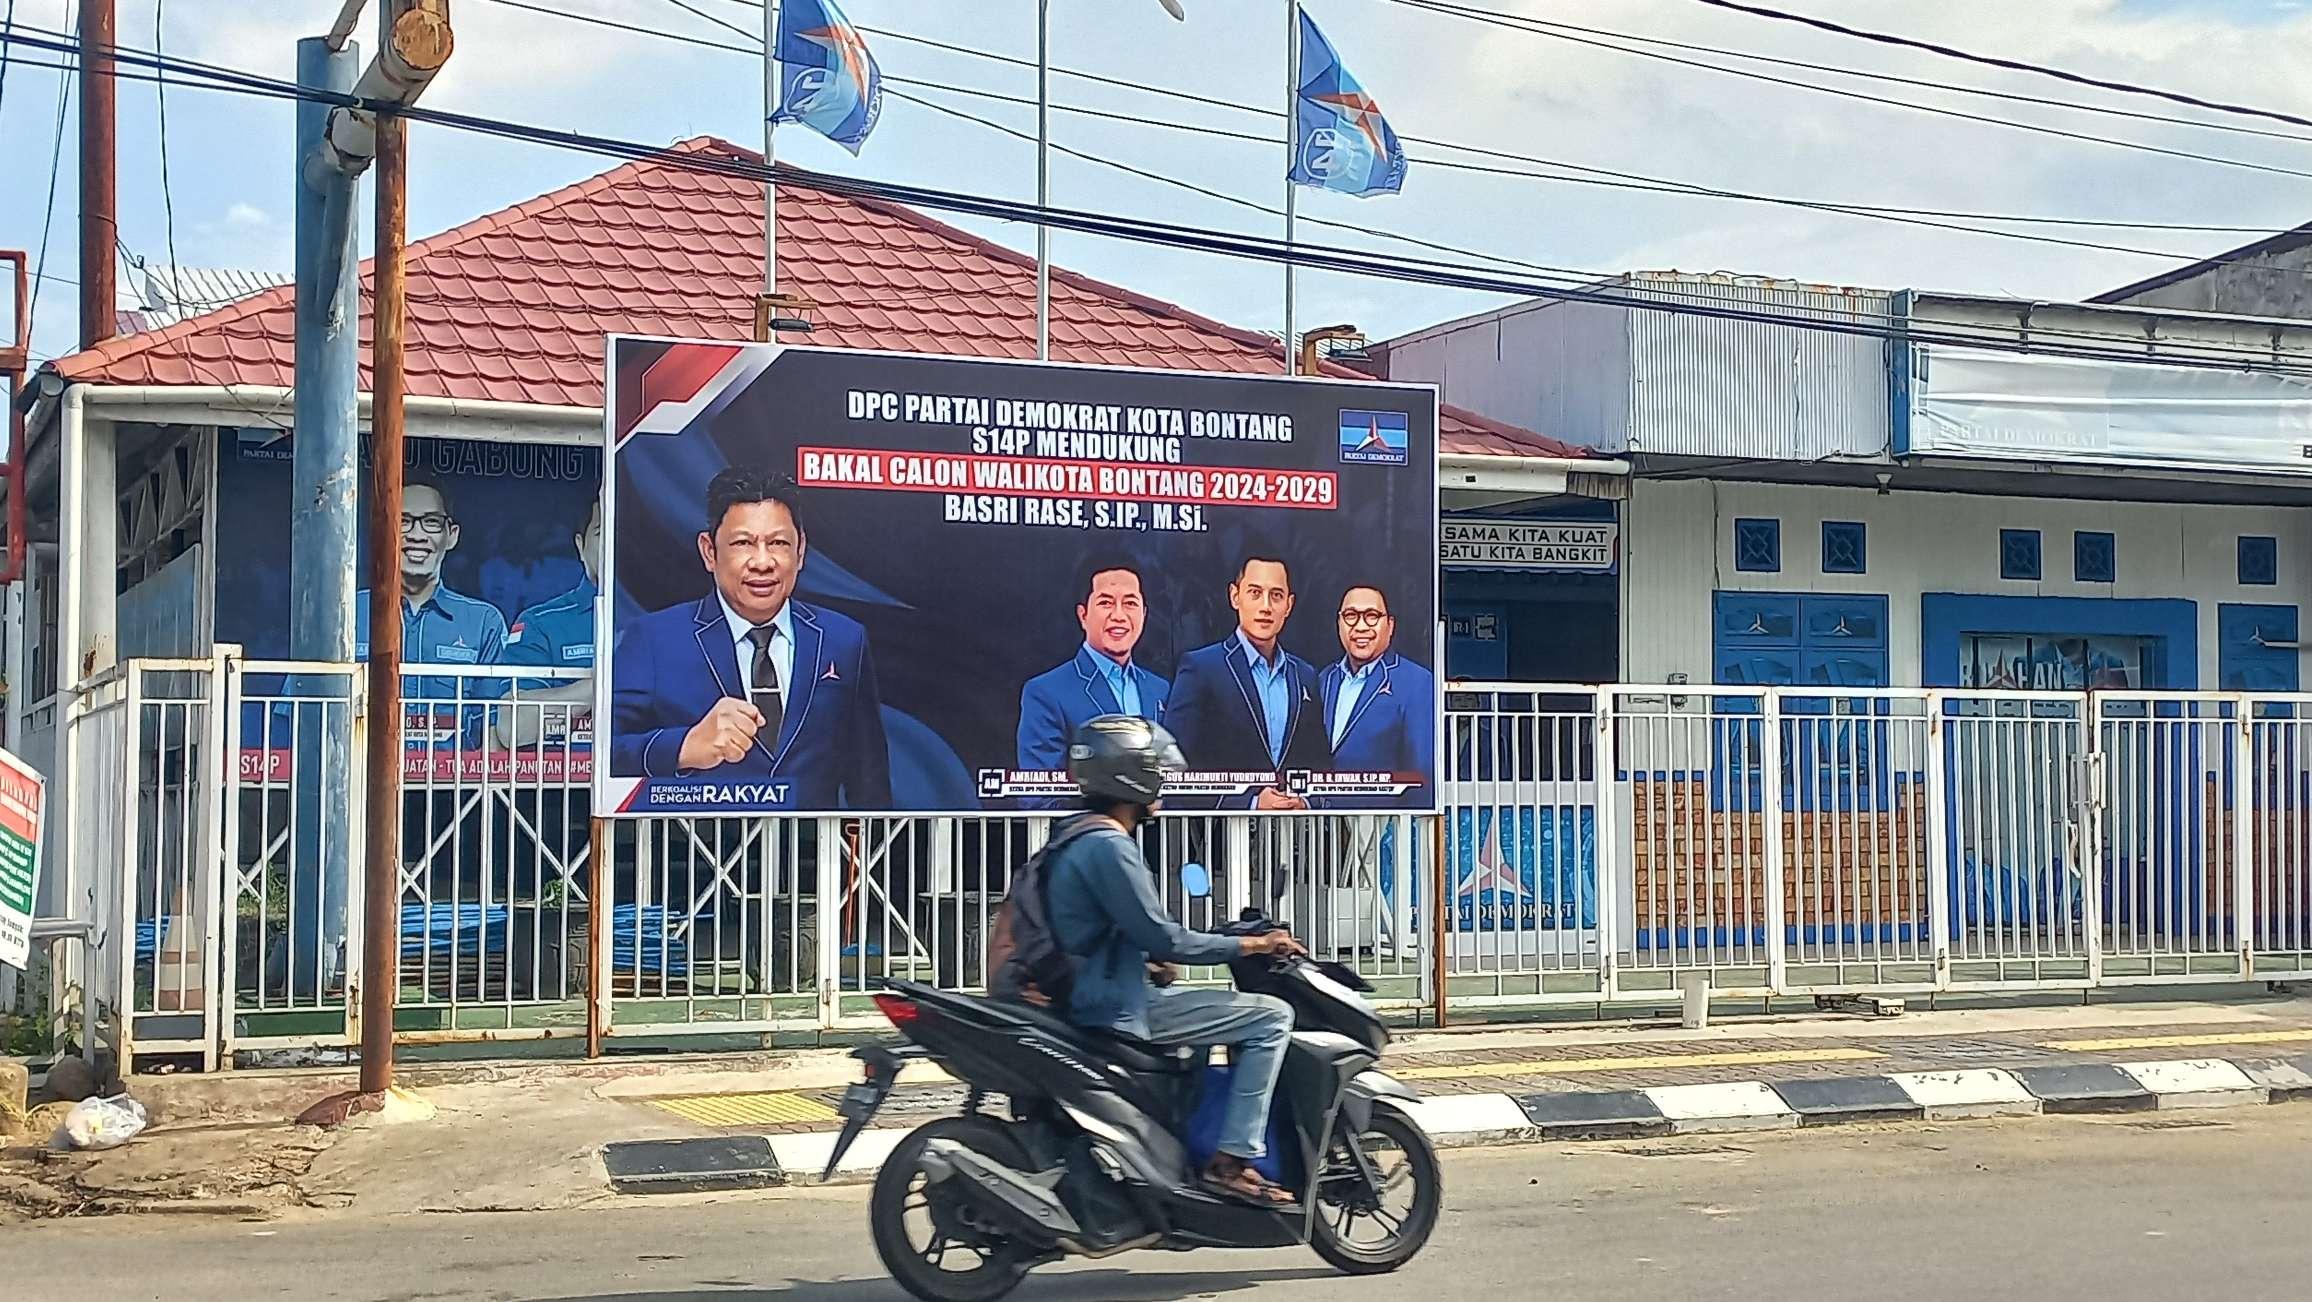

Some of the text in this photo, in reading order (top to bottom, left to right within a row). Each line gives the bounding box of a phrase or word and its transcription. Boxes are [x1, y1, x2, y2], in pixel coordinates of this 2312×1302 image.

[848, 391, 1294, 442] DPC PARTAI DEMOKRAT KOTA BONTANG
[432, 438, 584, 481] GABUNG
[972, 427, 1181, 464] S14P MENDUKUNG
[803, 453, 1333, 504] BAKAL CALON WALIKOTA BONTANG 2024-2029
[945, 495, 1018, 524] BASRI
[1024, 498, 1089, 529] RASE,
[1095, 502, 1148, 532] S.IP.,
[1444, 526, 1608, 544] SAMA KITA KUAT
[1440, 544, 1608, 562] SATU KITA BANGKIT
[650, 793, 701, 804] DENGAN
[651, 785, 702, 794] BERKOALISI
[702, 784, 790, 803] RAKYAT
